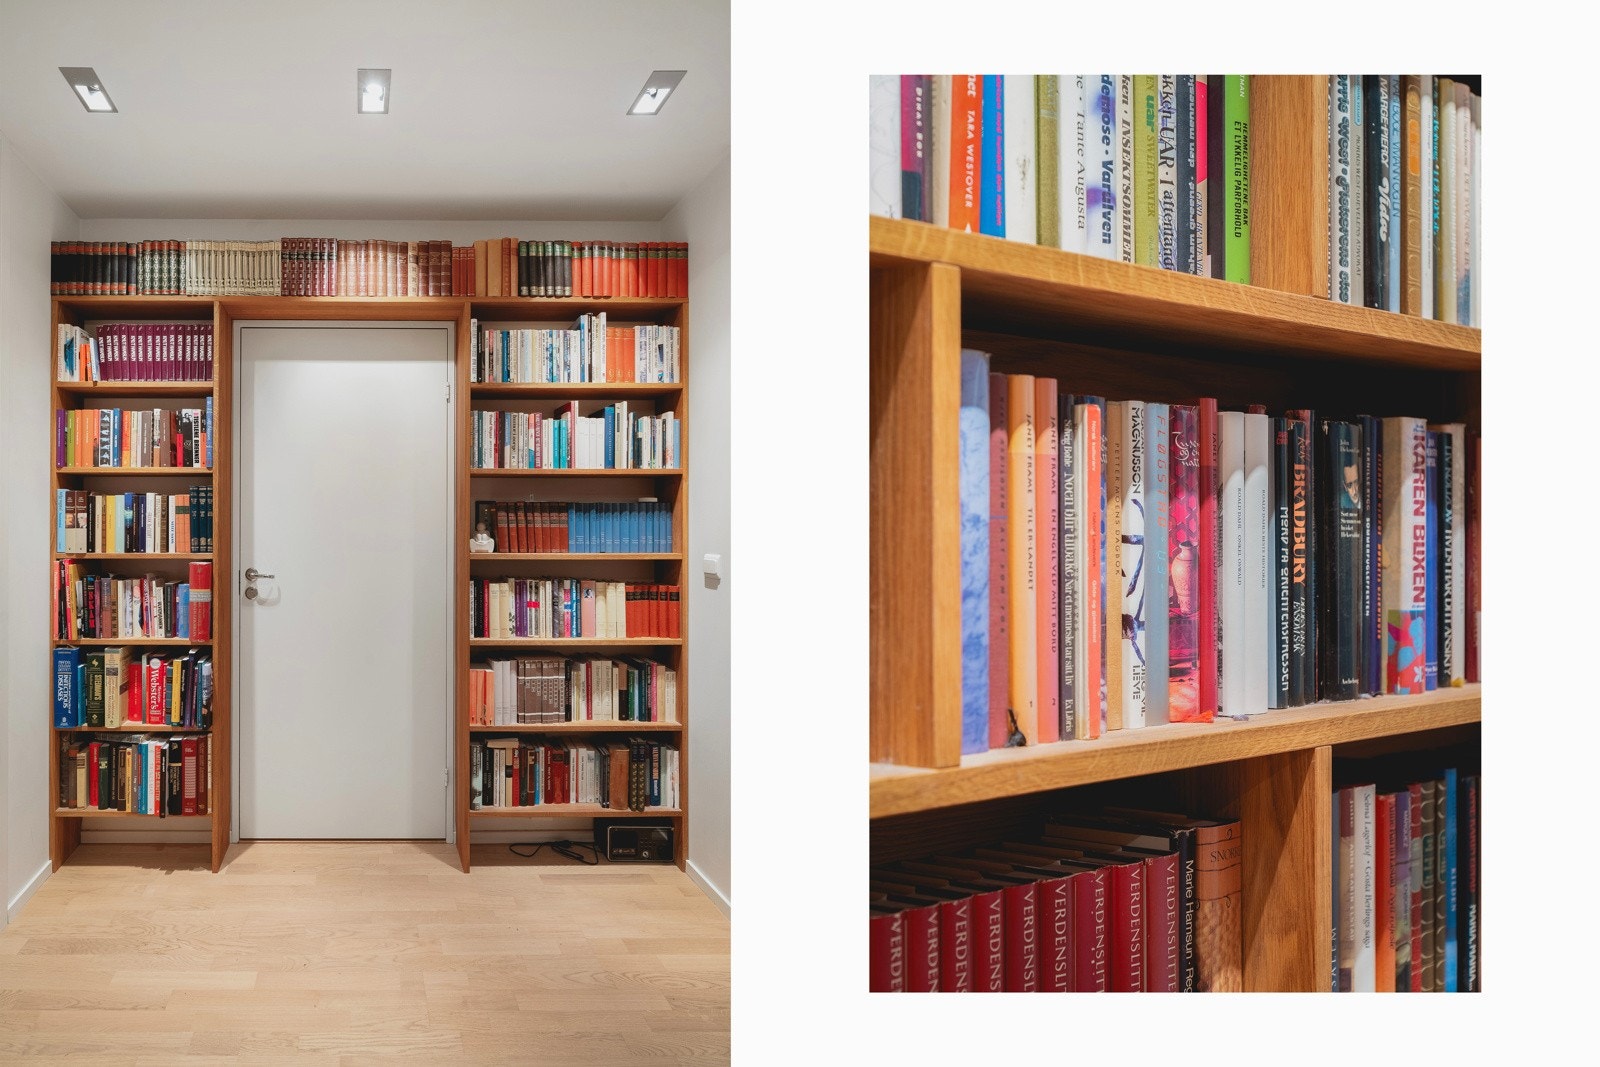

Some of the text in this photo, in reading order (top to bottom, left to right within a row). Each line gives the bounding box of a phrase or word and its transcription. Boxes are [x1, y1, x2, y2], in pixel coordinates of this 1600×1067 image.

[915, 87, 923, 159] DINAS BOK
[964, 110, 975, 208] TARA WESTOVER
[1338, 116, 1350, 167] West
[1380, 125, 1390, 168] PIERCY
[1074, 110, 1086, 229] Tante Augusta
[1102, 160, 1114, 244] Varulven
[1121, 119, 1131, 263] INSEKTSOMMER
[1147, 135, 1155, 217] SWEETWATER
[1234, 121, 1242, 238] ET LYKKELIG PARFORHOLD
[1335, 176, 1350, 267] Fiskerens
[1378, 177, 1391, 242] Vida
[1131, 407, 1141, 494] MAGNUSSON
[1157, 415, 1167, 529] FLØGSTAD
[1413, 435, 1425, 516] KAREN
[1051, 509, 1056, 523] EN
[1293, 463, 1306, 587] BRADBURY
[1061, 419, 1076, 732] Solveig Noen blir tilbake Når et menneske tar sitt liv Ex Libris
[1412, 525, 1425, 603] BLIXEN
[1444, 569, 1452, 597] HAR
[1091, 600, 1097, 609] og
[151, 670, 159, 709] Webster's
[1132, 665, 1140, 700] LEVE
[1185, 860, 1194, 898] Marie
[1363, 894, 1372, 928] Berlings
[1185, 902, 1194, 959] Hamsun
